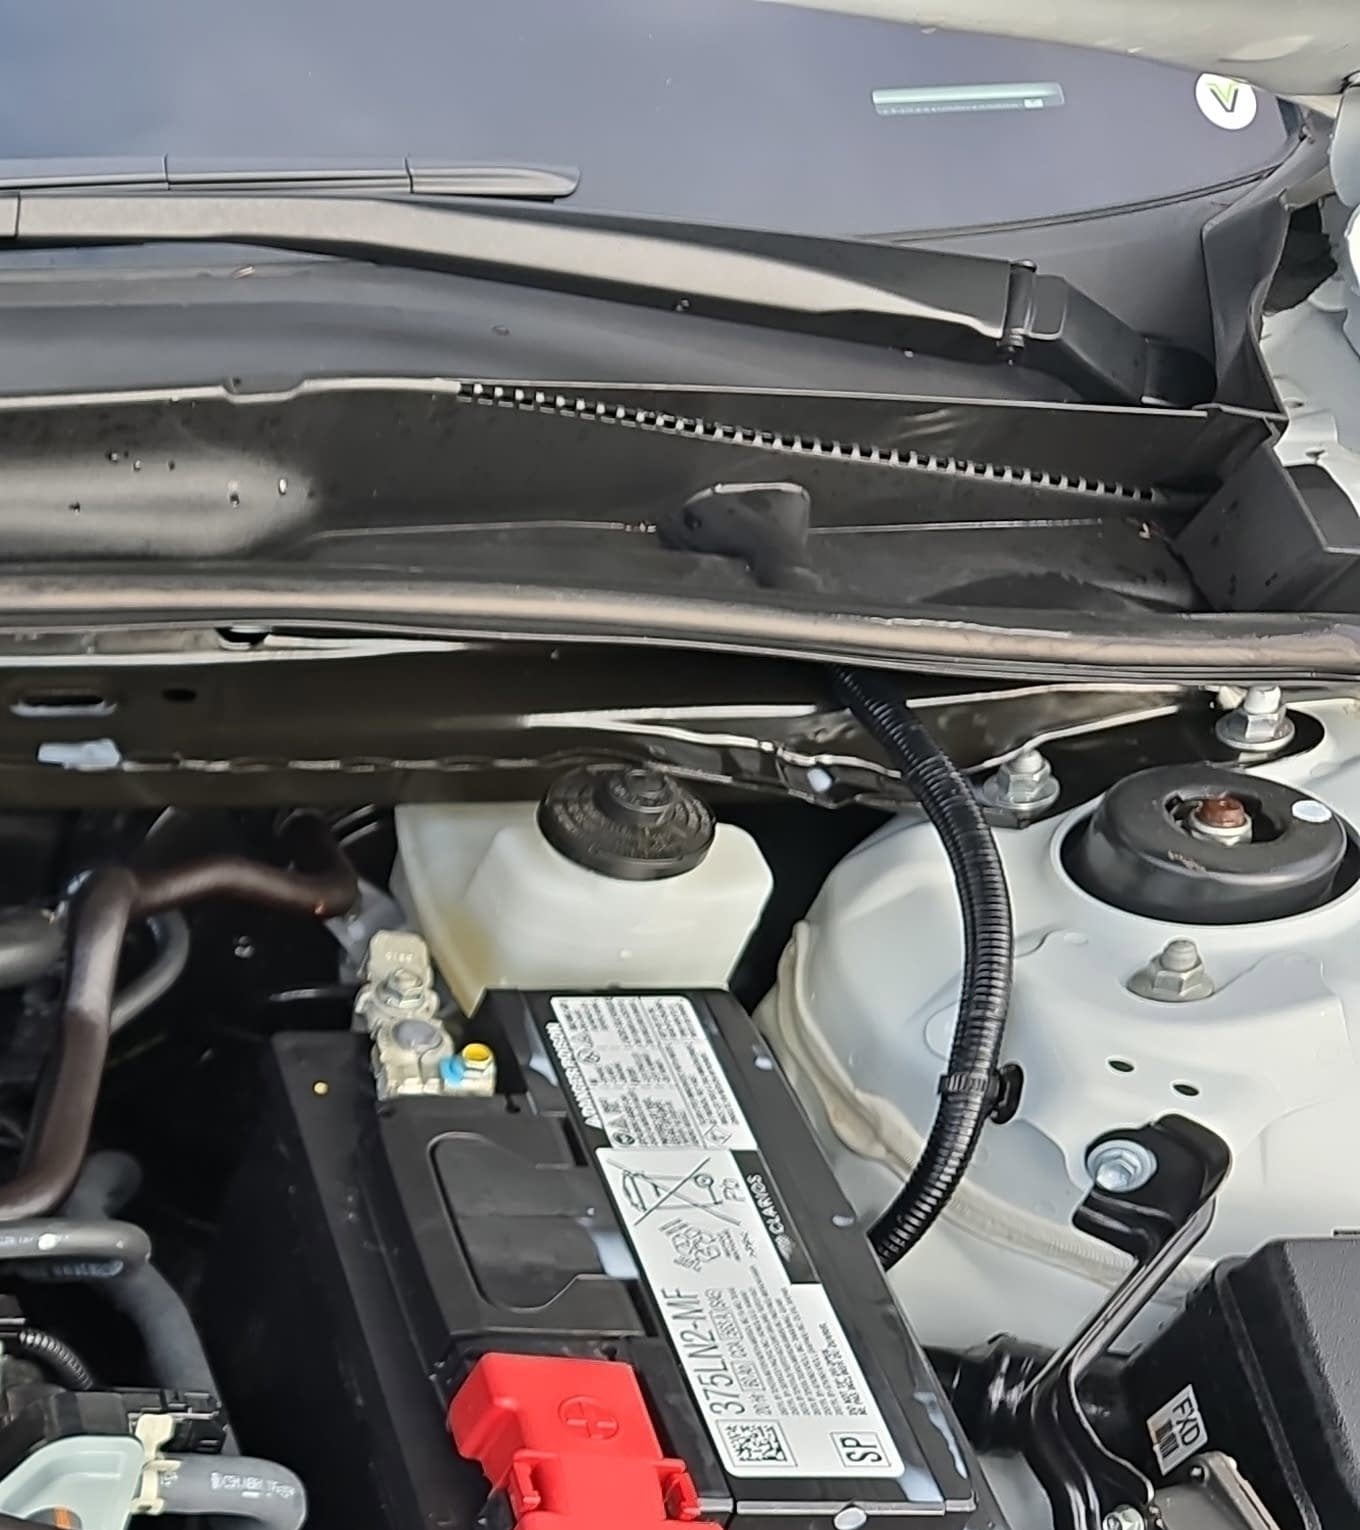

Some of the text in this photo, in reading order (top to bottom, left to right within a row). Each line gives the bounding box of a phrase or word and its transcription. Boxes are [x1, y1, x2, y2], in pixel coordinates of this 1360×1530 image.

[660, 1287, 746, 1416] 375LN2-MF
[1172, 1396, 1201, 1446] FXD
[838, 1437, 887, 1463] SP
